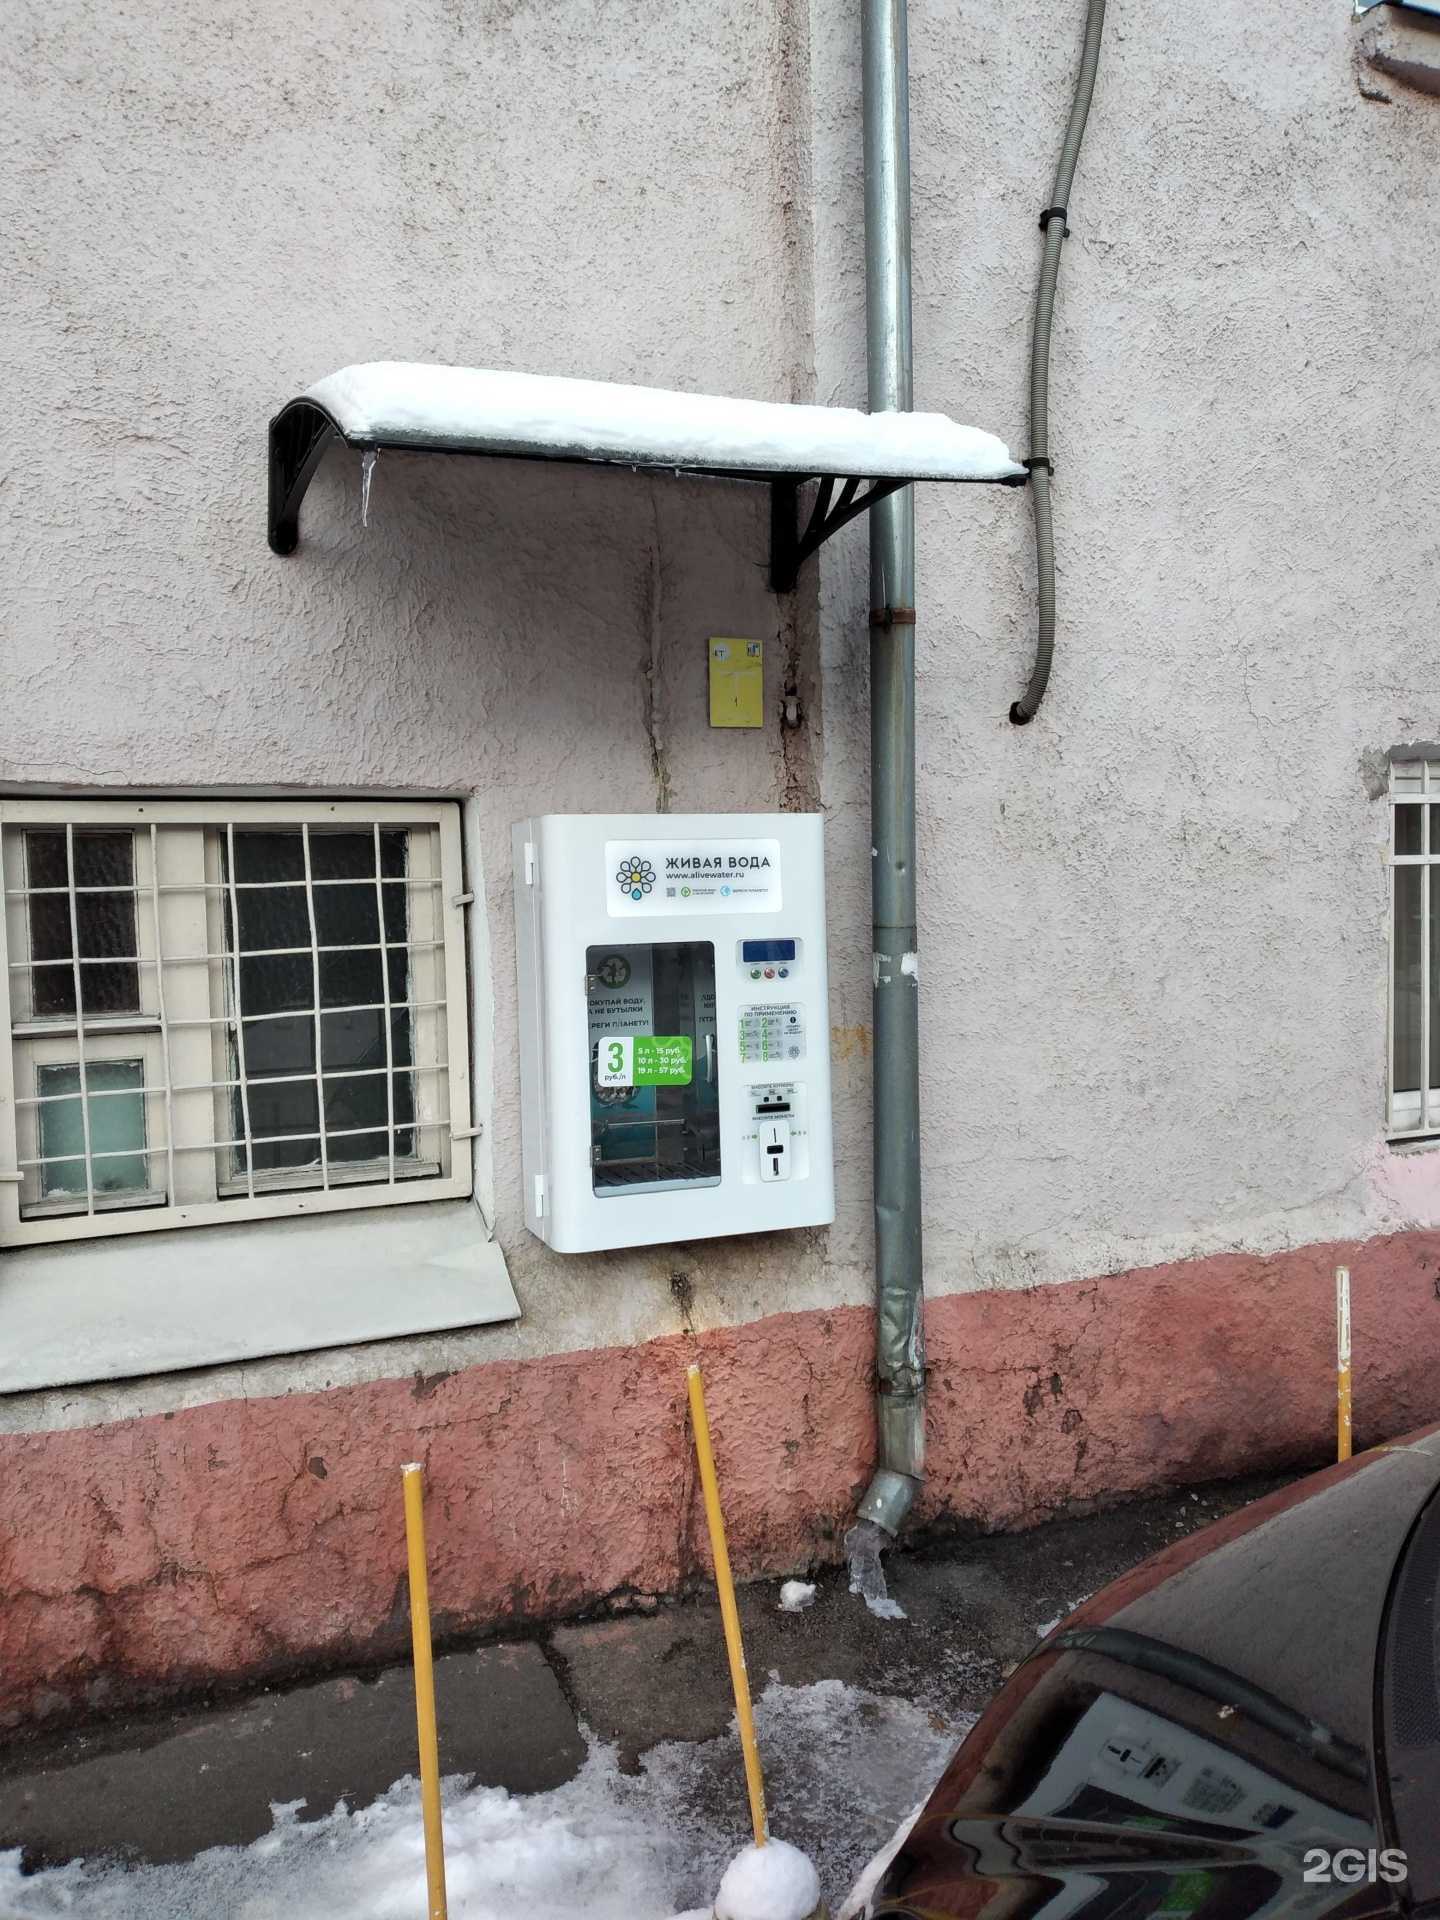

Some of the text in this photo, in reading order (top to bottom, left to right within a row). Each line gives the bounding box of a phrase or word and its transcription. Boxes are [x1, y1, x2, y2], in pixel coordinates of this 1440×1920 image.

[665, 856, 771, 869] ЖИВАЯ ВОДА
[665, 871, 745, 879] www.alivewater.ru
[588, 998, 622, 1007] ОКУПАЙ
[606, 1006, 643, 1014] БУТЫЛКИ
[608, 1042, 624, 1073] 3
[658, 1066, 669, 1074] 57
